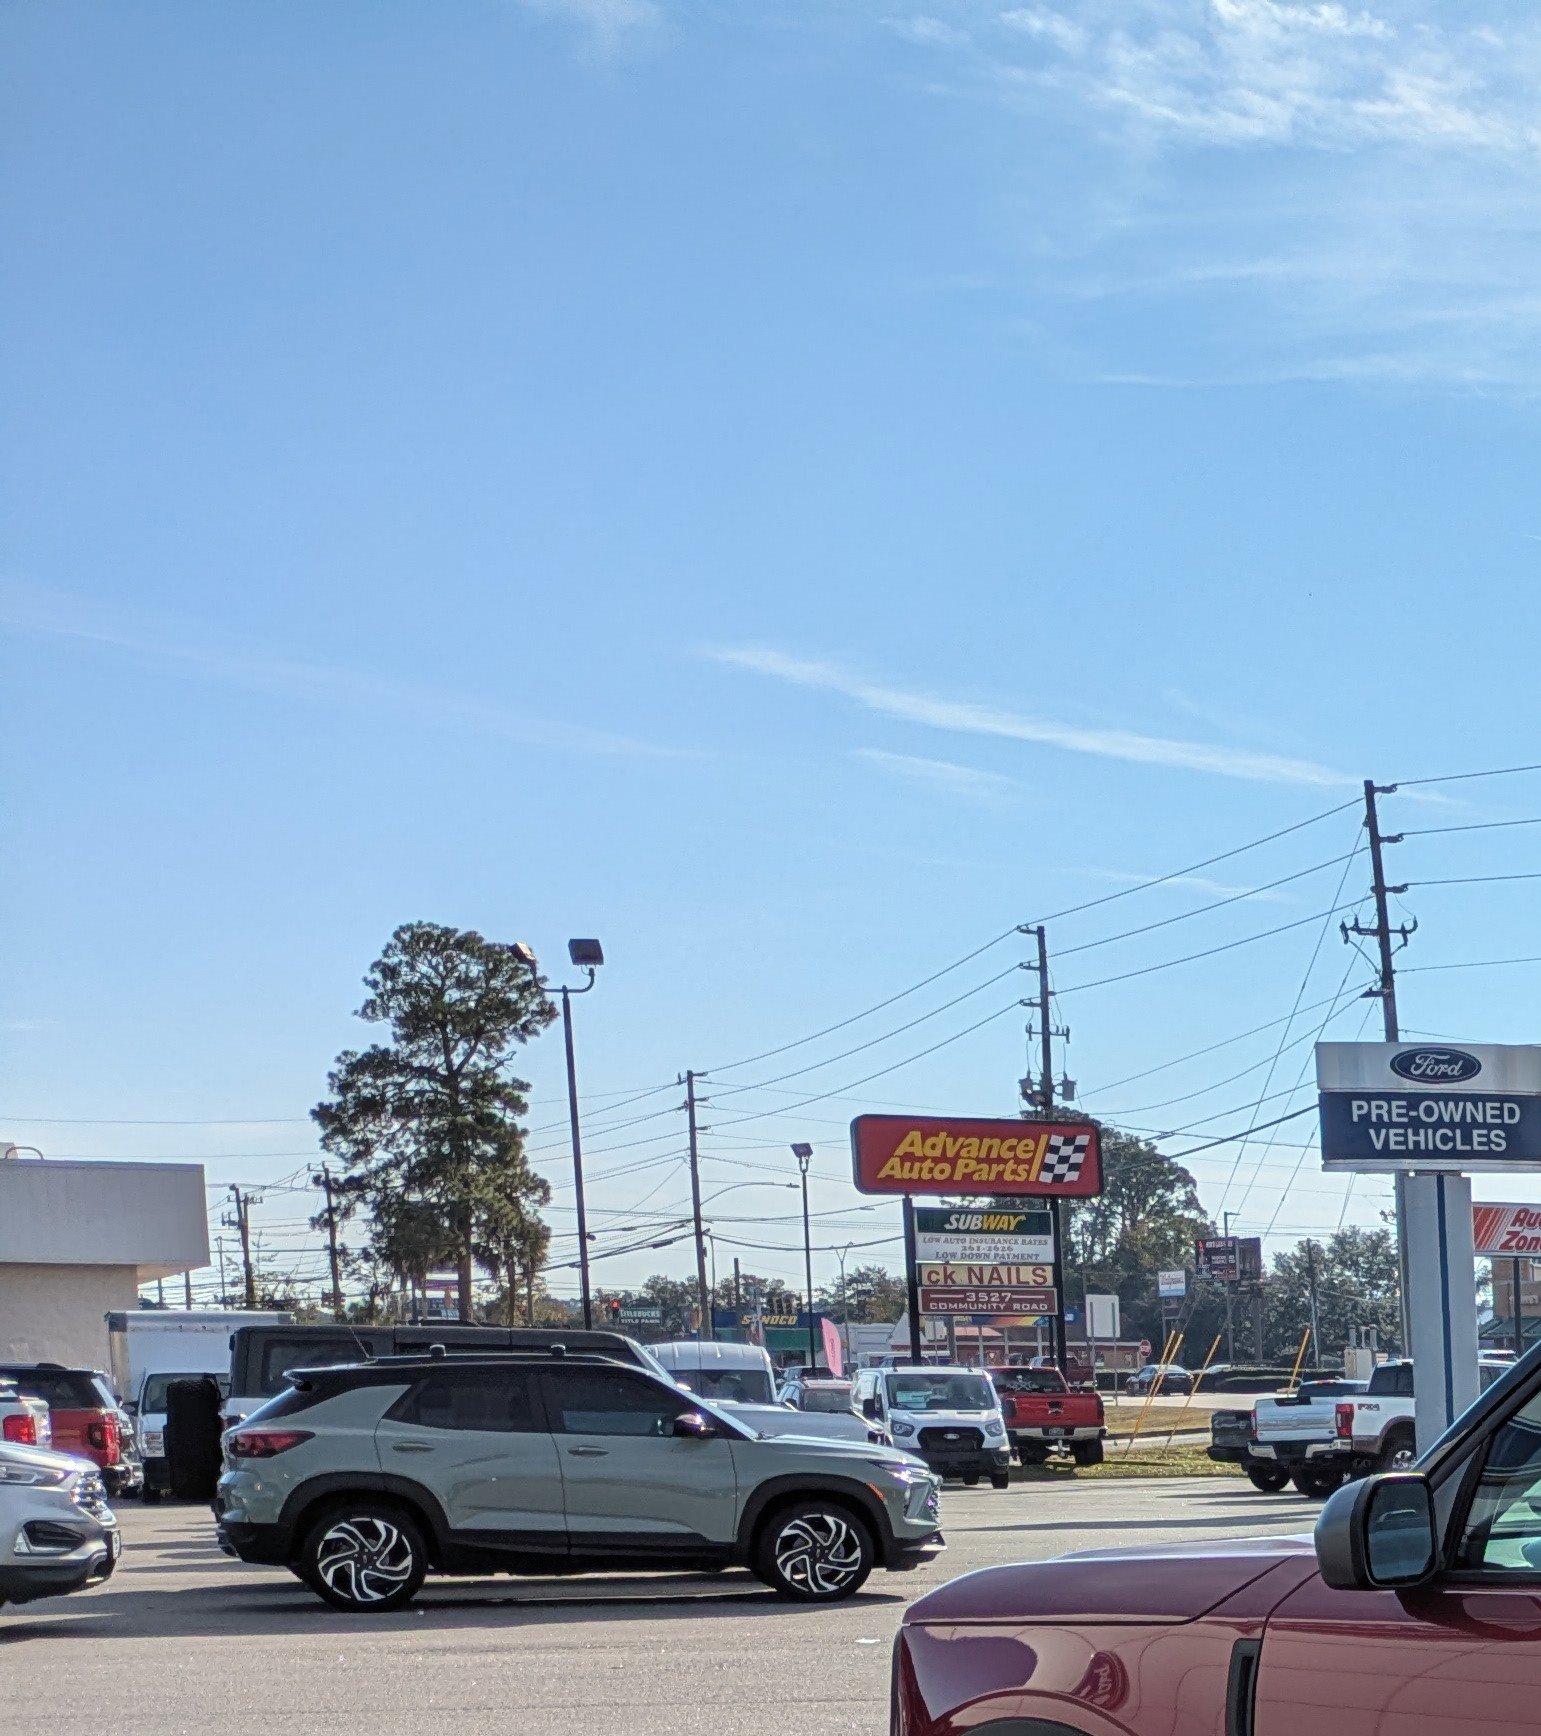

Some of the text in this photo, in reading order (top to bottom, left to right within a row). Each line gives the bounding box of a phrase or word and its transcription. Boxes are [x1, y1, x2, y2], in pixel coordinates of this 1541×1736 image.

[1410, 1053, 1463, 1077] Ford
[1351, 1100, 1521, 1124] PRE-OWNED
[894, 1130, 1035, 1159] Advance
[1369, 1128, 1507, 1151] VEHICLES
[877, 1157, 1030, 1182] Auto Parts
[944, 1214, 1026, 1231] SUBWAY
[923, 1236, 943, 1244] LOW
[944, 1237, 967, 1245] AUTO
[969, 1237, 1020, 1246] INSURANCE
[935, 1252, 1040, 1261] LOW DOWN PAYMENT
[926, 1265, 1048, 1286] ck NAILS
[930, 1303, 1048, 1311] COMMUNITY ROAD
[966, 1292, 1012, 1302] 3527
